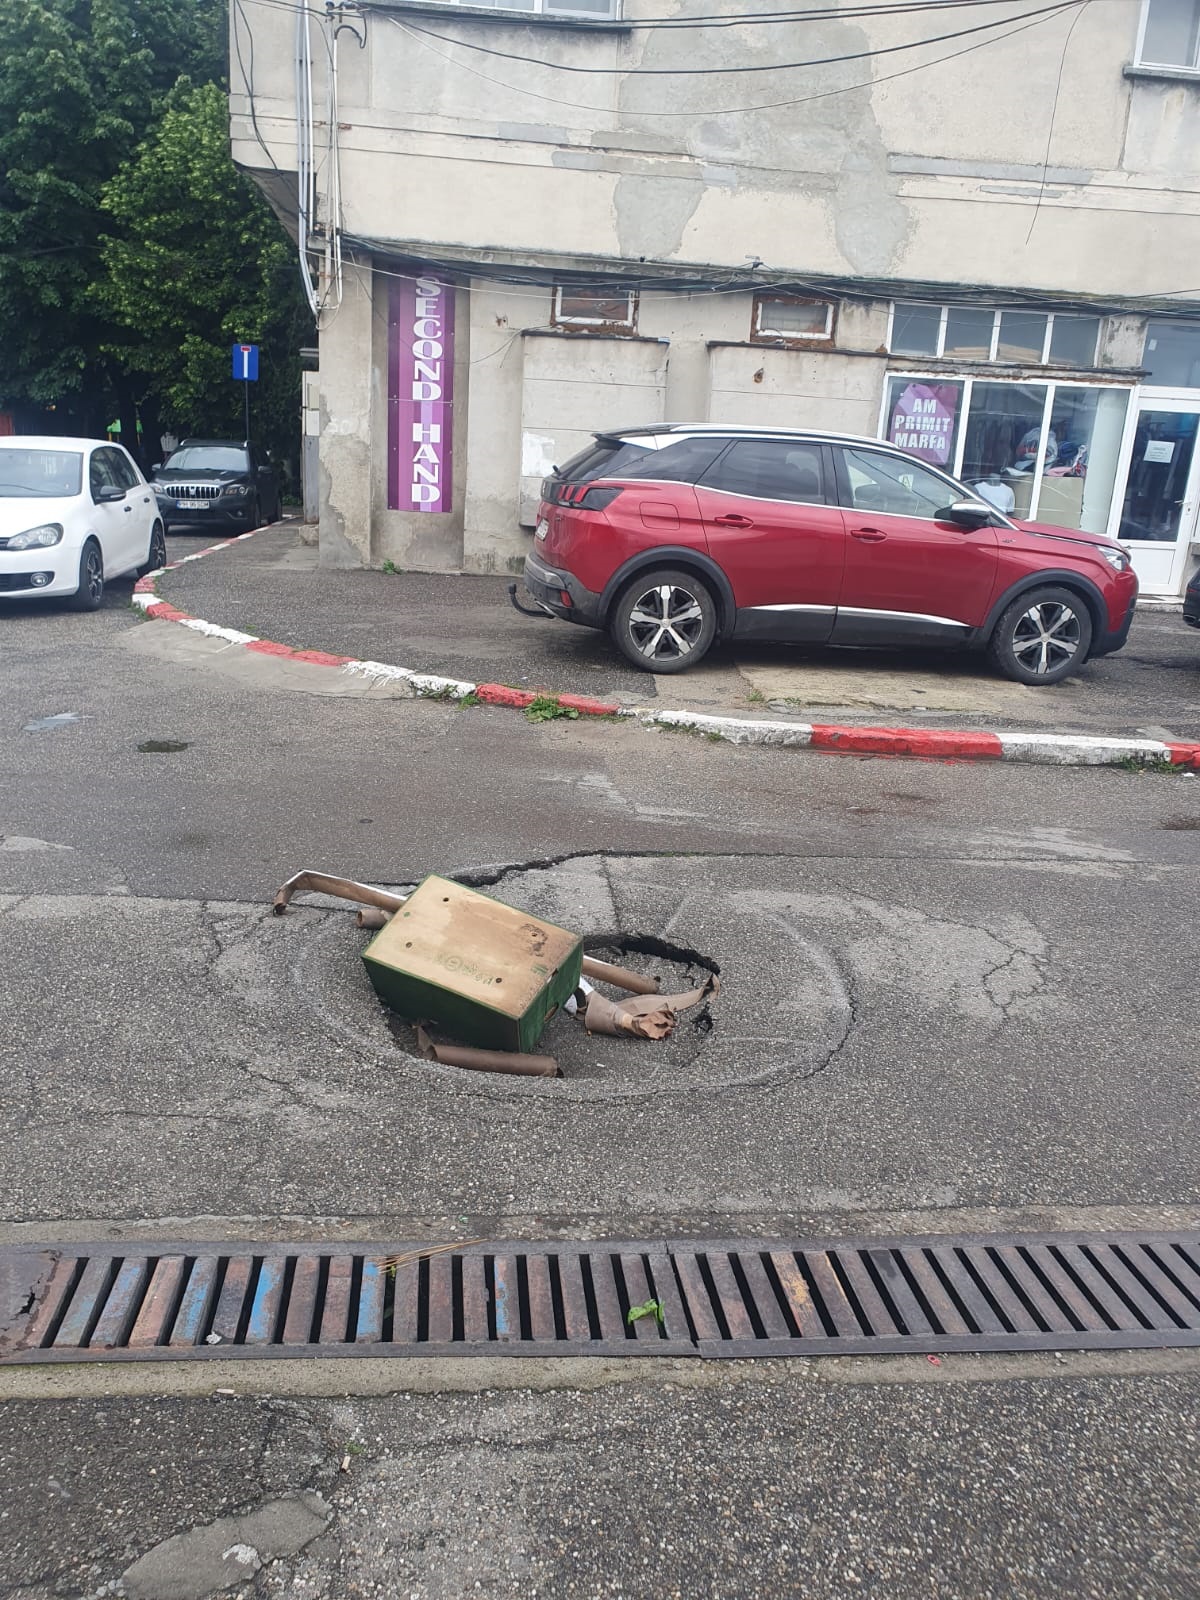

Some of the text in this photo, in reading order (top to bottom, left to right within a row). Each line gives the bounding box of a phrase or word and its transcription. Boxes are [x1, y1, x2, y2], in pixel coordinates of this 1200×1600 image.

[411, 276, 443, 503] SECOND HAND
[912, 398, 937, 414] AM
[894, 414, 951, 432] PRIMIT
[894, 432, 946, 449] MARFA
